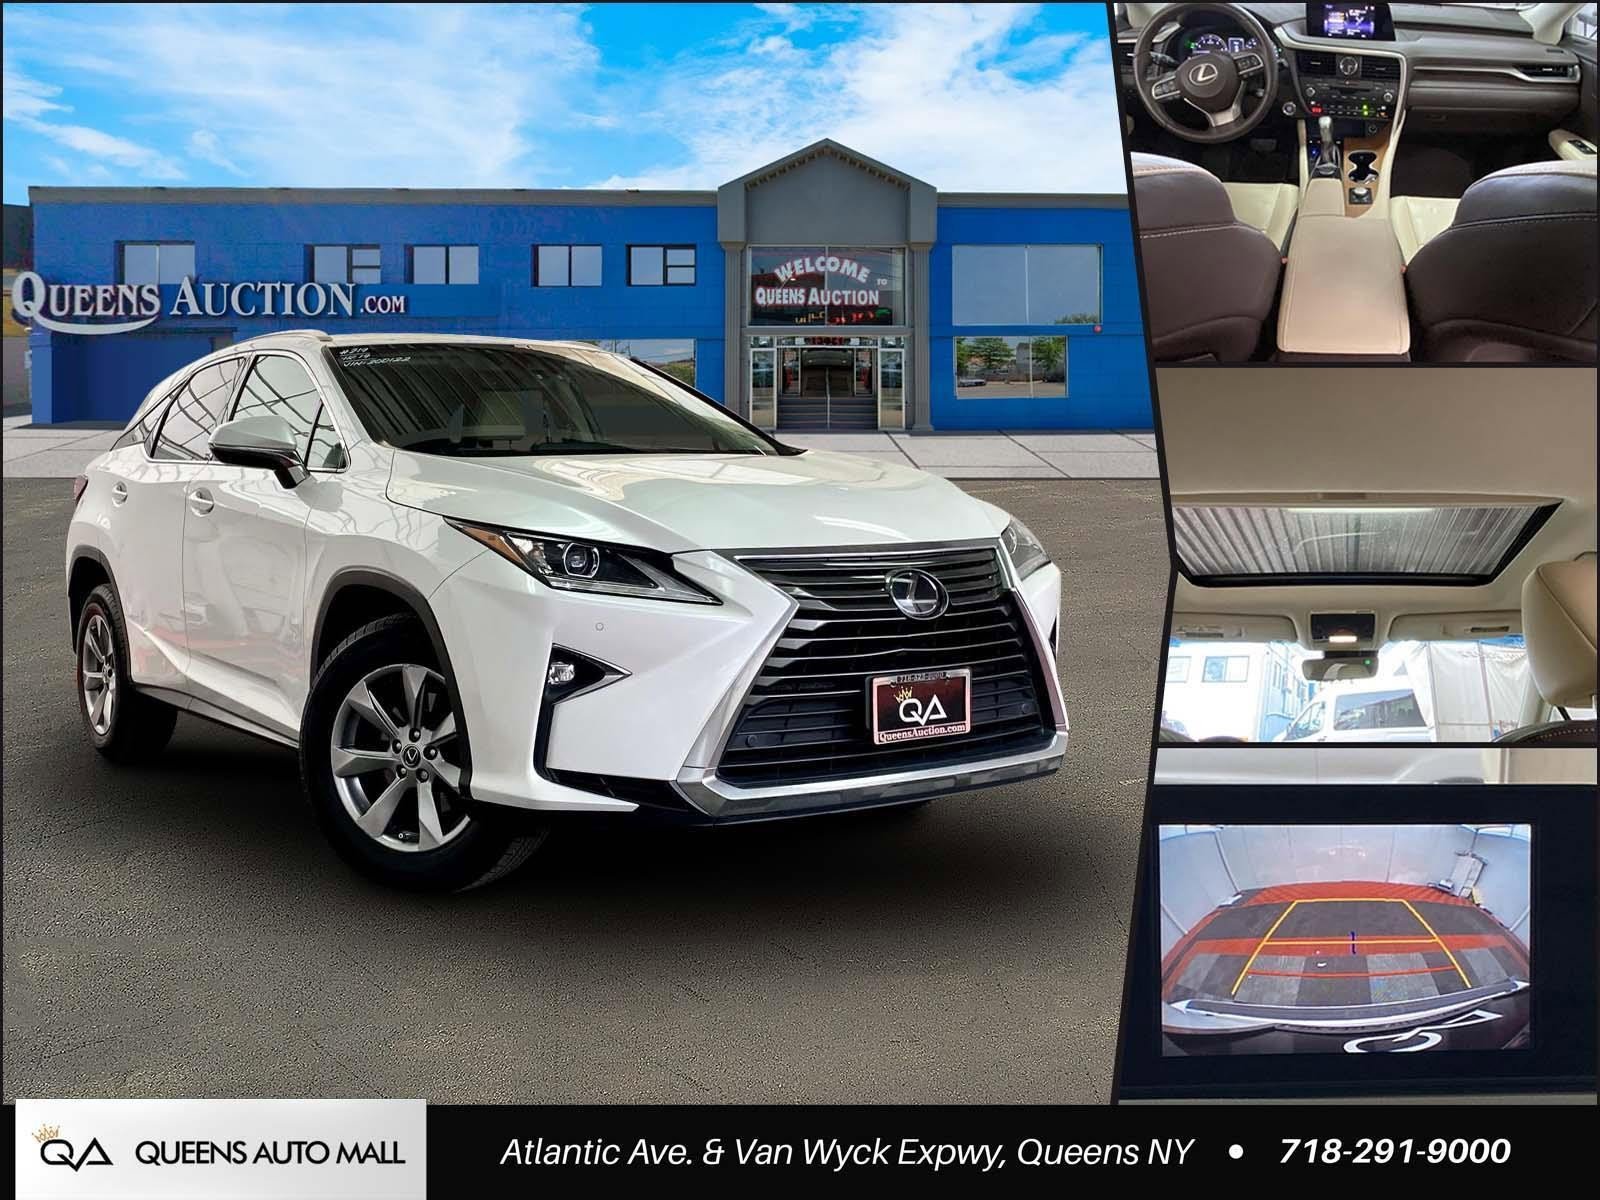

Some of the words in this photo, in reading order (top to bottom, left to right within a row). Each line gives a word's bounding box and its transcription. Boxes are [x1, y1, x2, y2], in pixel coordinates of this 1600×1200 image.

[774, 256, 871, 283] WELCOME
[877, 278, 888, 286] TO
[12, 271, 161, 335] QUEENS
[169, 276, 356, 318] AUCTION
[755, 287, 805, 306] QUEENS
[808, 287, 879, 306] AUCTION
[879, 723, 966, 742] QueensAuction.com
